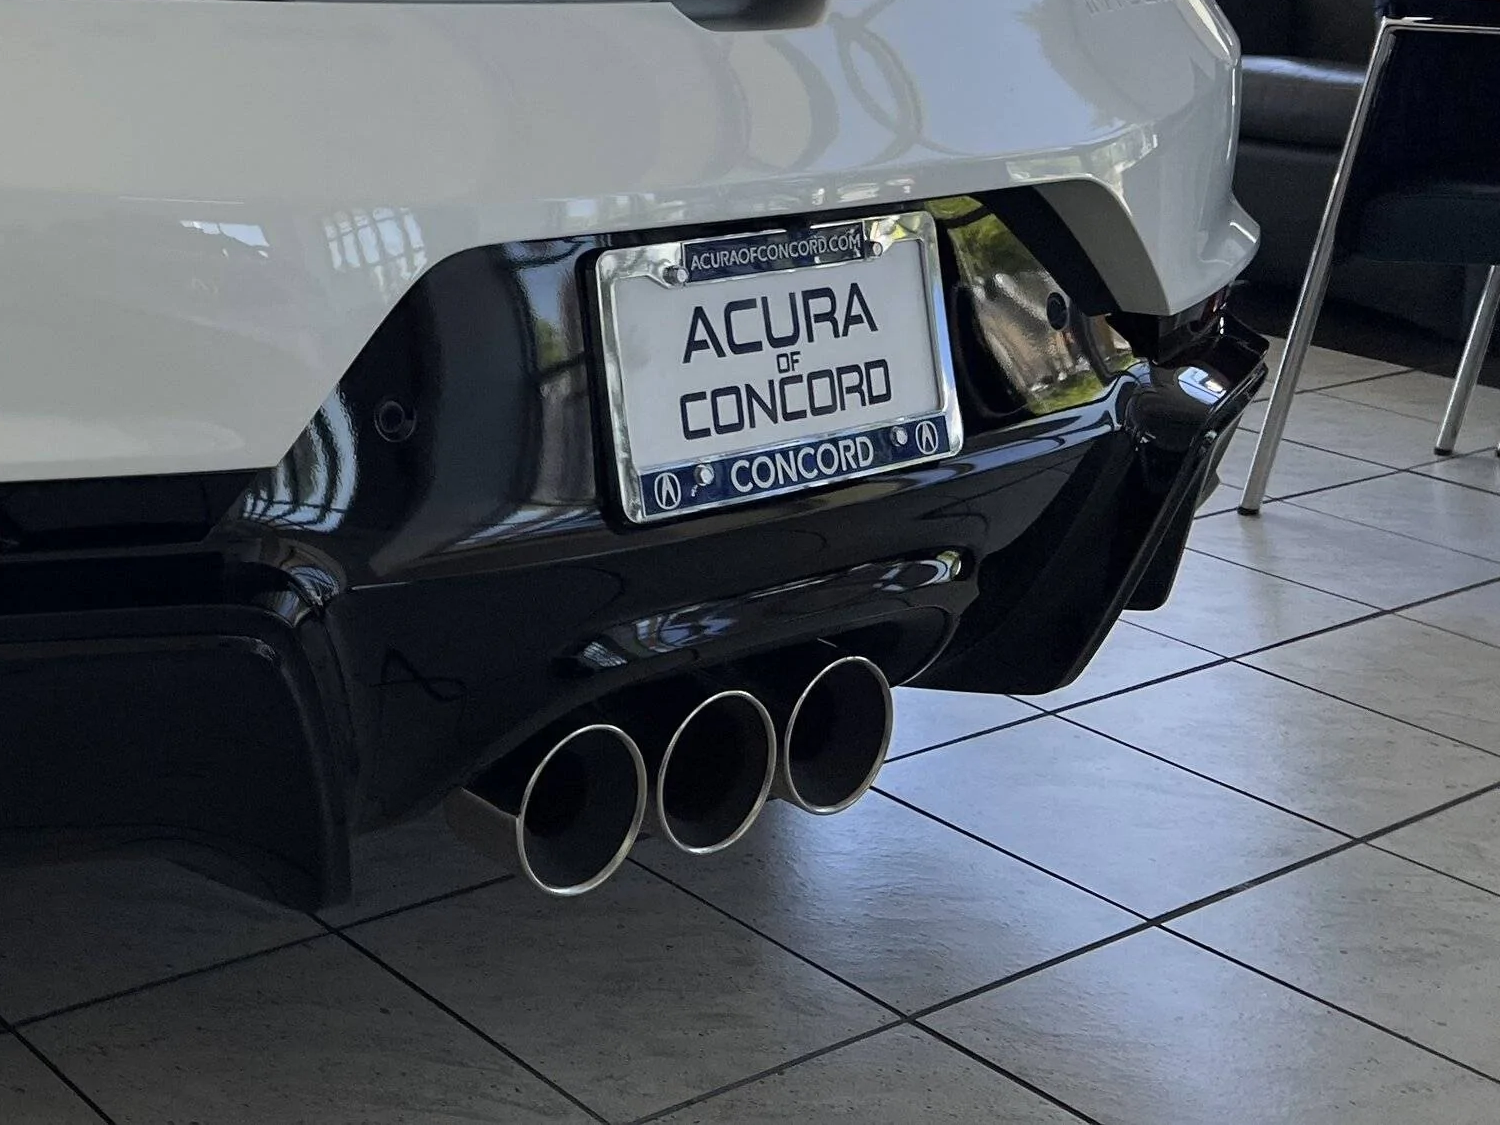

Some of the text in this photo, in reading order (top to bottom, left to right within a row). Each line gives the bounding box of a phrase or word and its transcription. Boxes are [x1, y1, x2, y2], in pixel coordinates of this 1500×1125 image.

[690, 234, 862, 272] ACURAOFCONCORD.COM
[682, 282, 879, 364] ACURA
[776, 350, 801, 374] OF
[679, 358, 892, 441] CONCORD
[729, 436, 875, 493] CONCORD
